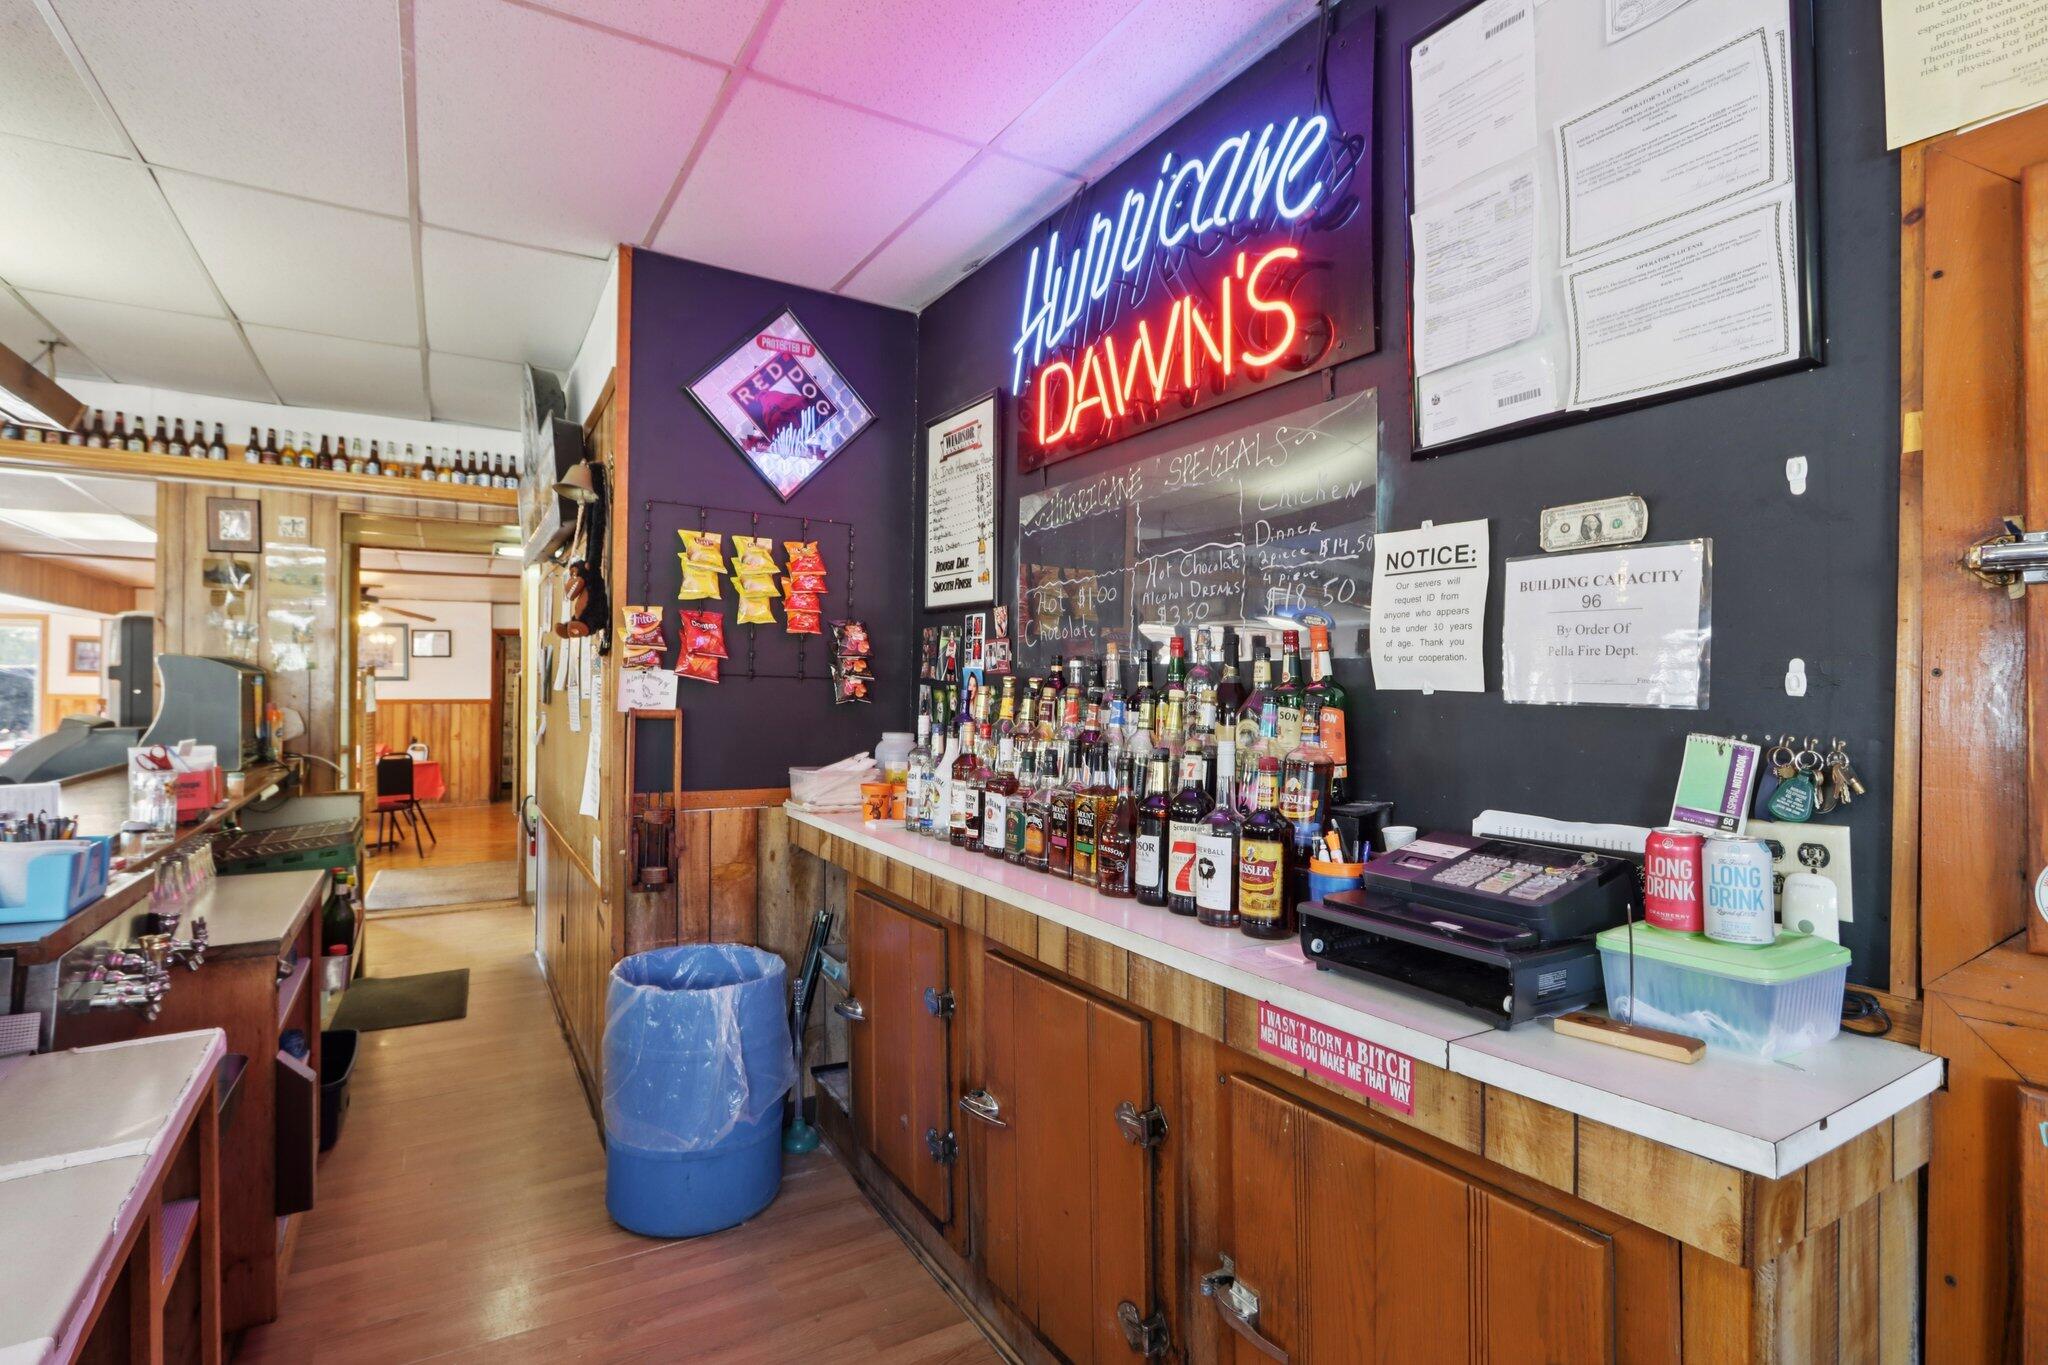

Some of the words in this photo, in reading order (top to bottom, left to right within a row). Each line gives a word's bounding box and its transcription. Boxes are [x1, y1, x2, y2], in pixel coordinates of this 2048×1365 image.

[1917, 12, 1969, 36] especially
[1973, 6, 1984, 16] to
[1935, 17, 1982, 41] pregnant
[1921, 43, 1973, 65] Thorough
[1976, 27, 2021, 47] cooking
[2023, 19, 2035, 29] of
[1930, 27, 1989, 52] individuals
[1992, 17, 2017, 30] with
[1920, 65, 1940, 77] risk
[1943, 58, 1955, 68] of
[2001, 38, 2021, 49] For
[1956, 54, 2008, 76] physician
[2011, 48, 2024, 57] or
[761, 337, 801, 354] PROTECTED
[801, 344, 811, 356] BY
[1038, 246, 1299, 446] DAWN'S
[737, 362, 784, 405] RED
[788, 365, 831, 416] DOG
[945, 426, 975, 450] WINDSOR
[1164, 426, 1288, 486] SPECIALS
[935, 560, 955, 573] ROUGH
[1146, 558, 1172, 589] Hot
[1179, 549, 1241, 577] Chocolate
[1386, 544, 1477, 571] NOTICE:
[933, 580, 955, 593] SMOOTH
[1395, 582, 1410, 590] Our
[1414, 579, 1442, 588] servers
[1446, 577, 1461, 586] will
[1520, 575, 1589, 592] BUILDING
[1593, 569, 1684, 588] CAPACITY
[1033, 588, 1066, 614] Hot
[1394, 595, 1422, 605] request
[1426, 593, 1436, 602] ID
[1440, 592, 1459, 601] from
[1581, 593, 1602, 609] 96
[1158, 602, 1210, 629] $3.50
[1383, 610, 1411, 620] anyone
[1415, 609, 1431, 617] who
[1436, 607, 1470, 617] appears
[1025, 616, 1097, 648] Chocolate
[1379, 626, 1387, 634] to
[1391, 625, 1400, 633] be
[1405, 623, 1428, 632] under
[1433, 622, 1444, 632] 30
[1449, 622, 1473, 632] years
[1556, 625, 1572, 638] By
[1575, 623, 1610, 635] Order
[1613, 622, 1632, 634] Of
[1385, 639, 1393, 648] of
[1397, 641, 1414, 650] age.
[1420, 638, 1444, 647] Thank
[1449, 639, 1465, 648] you
[1548, 645, 1574, 657] Pella
[1577, 645, 1601, 656] Fire
[1605, 644, 1639, 659] Dept.
[1383, 654, 1393, 662] for
[1398, 654, 1414, 664] your
[1418, 652, 1468, 662] cooperation.
[1186, 763, 1197, 778] 7
[1732, 754, 1747, 789] NOTEBOOK
[1727, 788, 1740, 811] SPIRAL
[1077, 809, 1094, 820] MOUNT
[1078, 818, 1093, 827] ROYAL
[1723, 817, 1734, 826] 60
[1649, 855, 1693, 880] LONG
[1711, 864, 1761, 888] LONG
[1647, 876, 1696, 901] DRINK
[1709, 885, 1764, 911] DRINK
[1260, 1007, 1264, 1023] I
[1267, 1009, 1307, 1040] WASN'T
[1310, 1026, 1342, 1055] BORN
[1345, 1041, 1353, 1059] A
[1357, 1040, 1411, 1084] BITCH
[1260, 1024, 1277, 1047] MEN
[1280, 1032, 1298, 1055] LIKE
[1300, 1040, 1318, 1063] YOU
[1320, 1048, 1345, 1075] MAKE
[1347, 1062, 1362, 1083] ME
[1364, 1066, 1387, 1094] THAT
[1389, 1076, 1411, 1103] WAY
